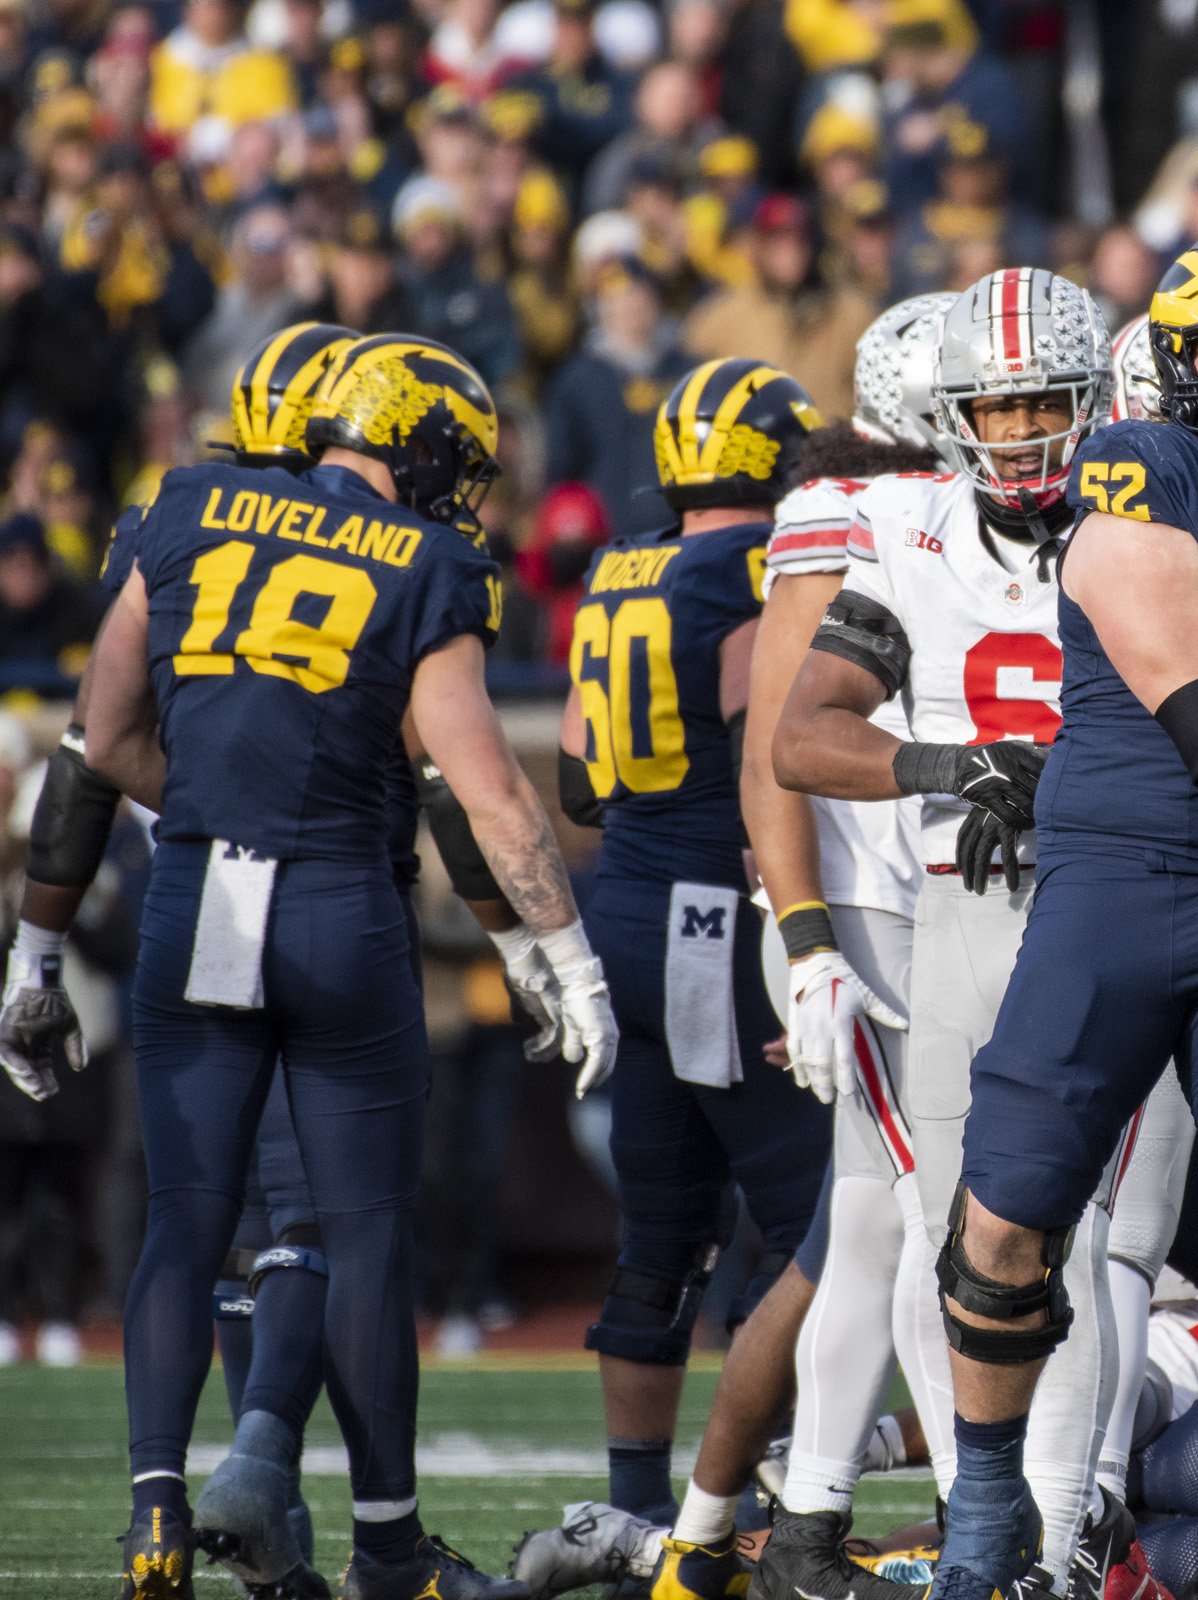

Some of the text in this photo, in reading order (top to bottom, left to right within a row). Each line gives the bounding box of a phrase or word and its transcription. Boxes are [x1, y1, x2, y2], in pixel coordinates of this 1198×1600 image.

[200, 487, 423, 568] LOVELAND
[1080, 462, 1151, 522] 52
[173, 540, 378, 694] 18
[569, 597, 690, 799] 60
[964, 632, 1064, 747] 6
[681, 905, 727, 940] M
